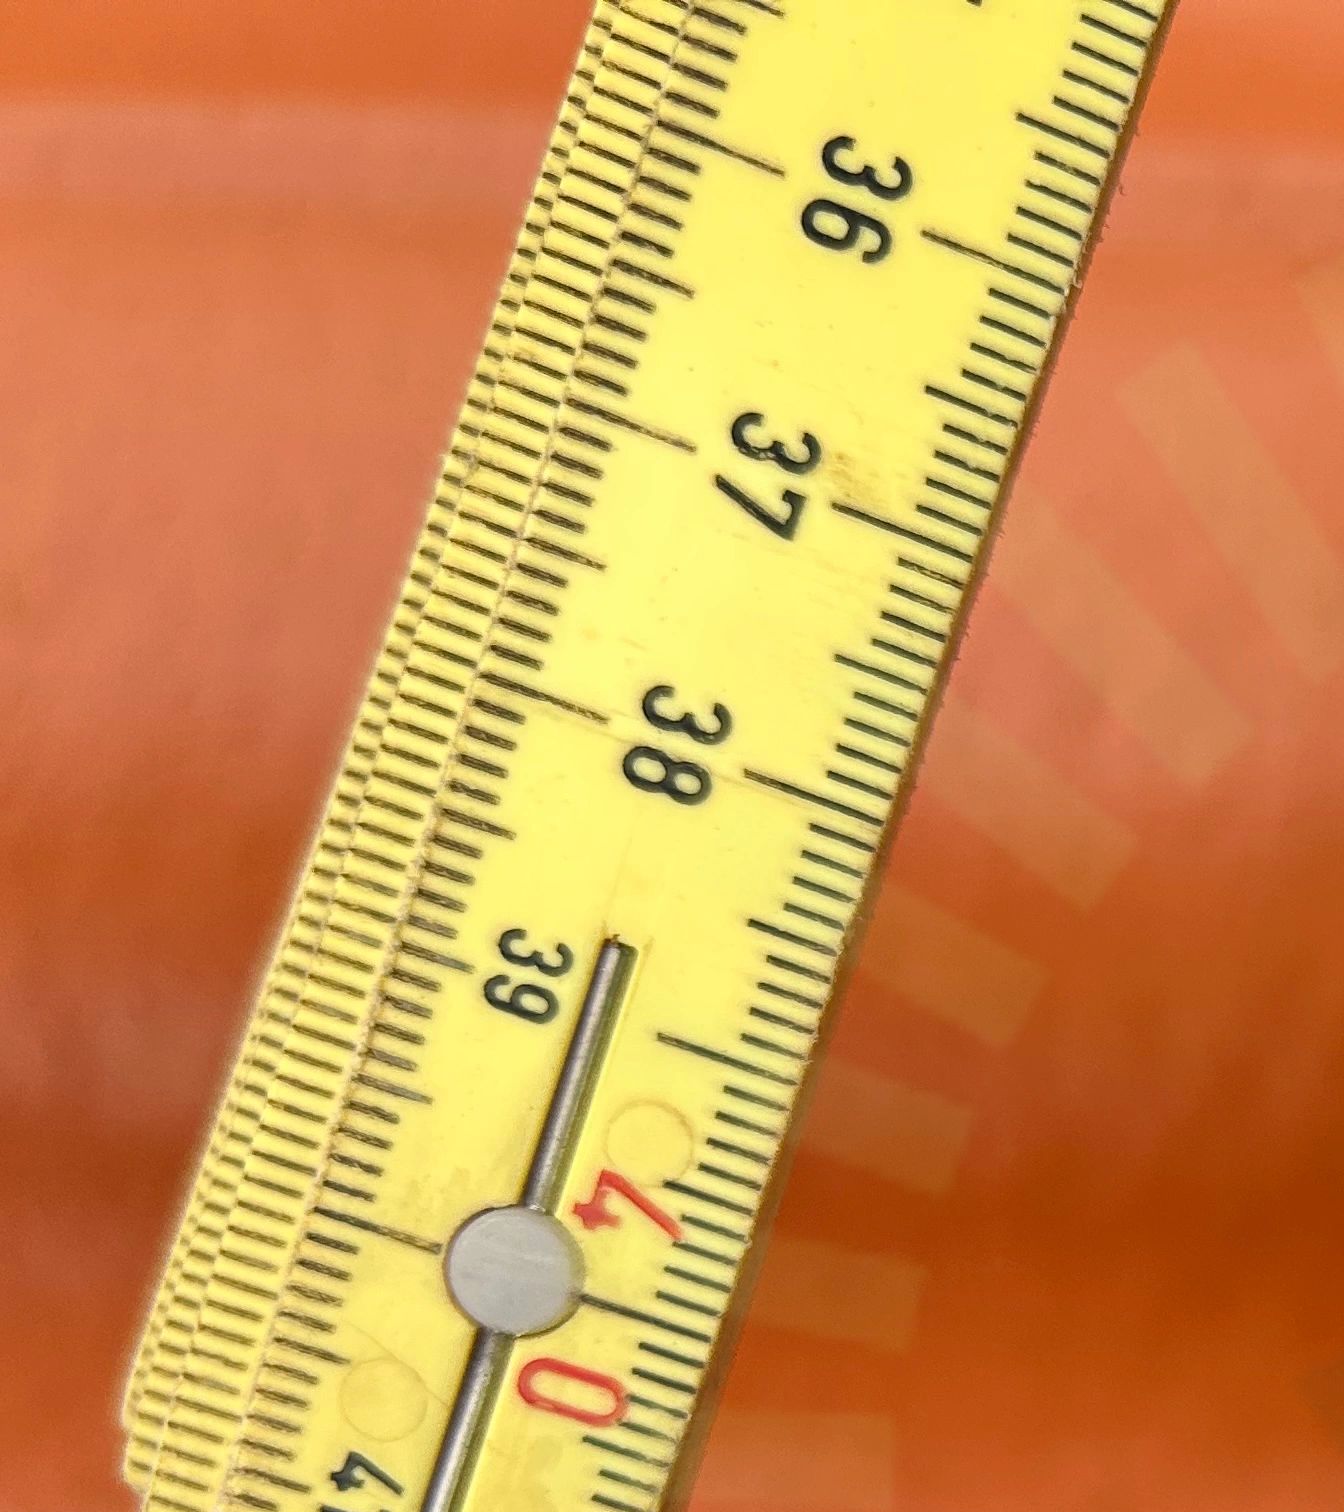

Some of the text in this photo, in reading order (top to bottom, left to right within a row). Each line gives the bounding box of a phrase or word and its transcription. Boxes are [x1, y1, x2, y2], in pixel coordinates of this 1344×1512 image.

[801, 136, 913, 264] 36
[715, 411, 822, 541] 37
[621, 684, 732, 806] 38
[483, 927, 573, 1024] 39
